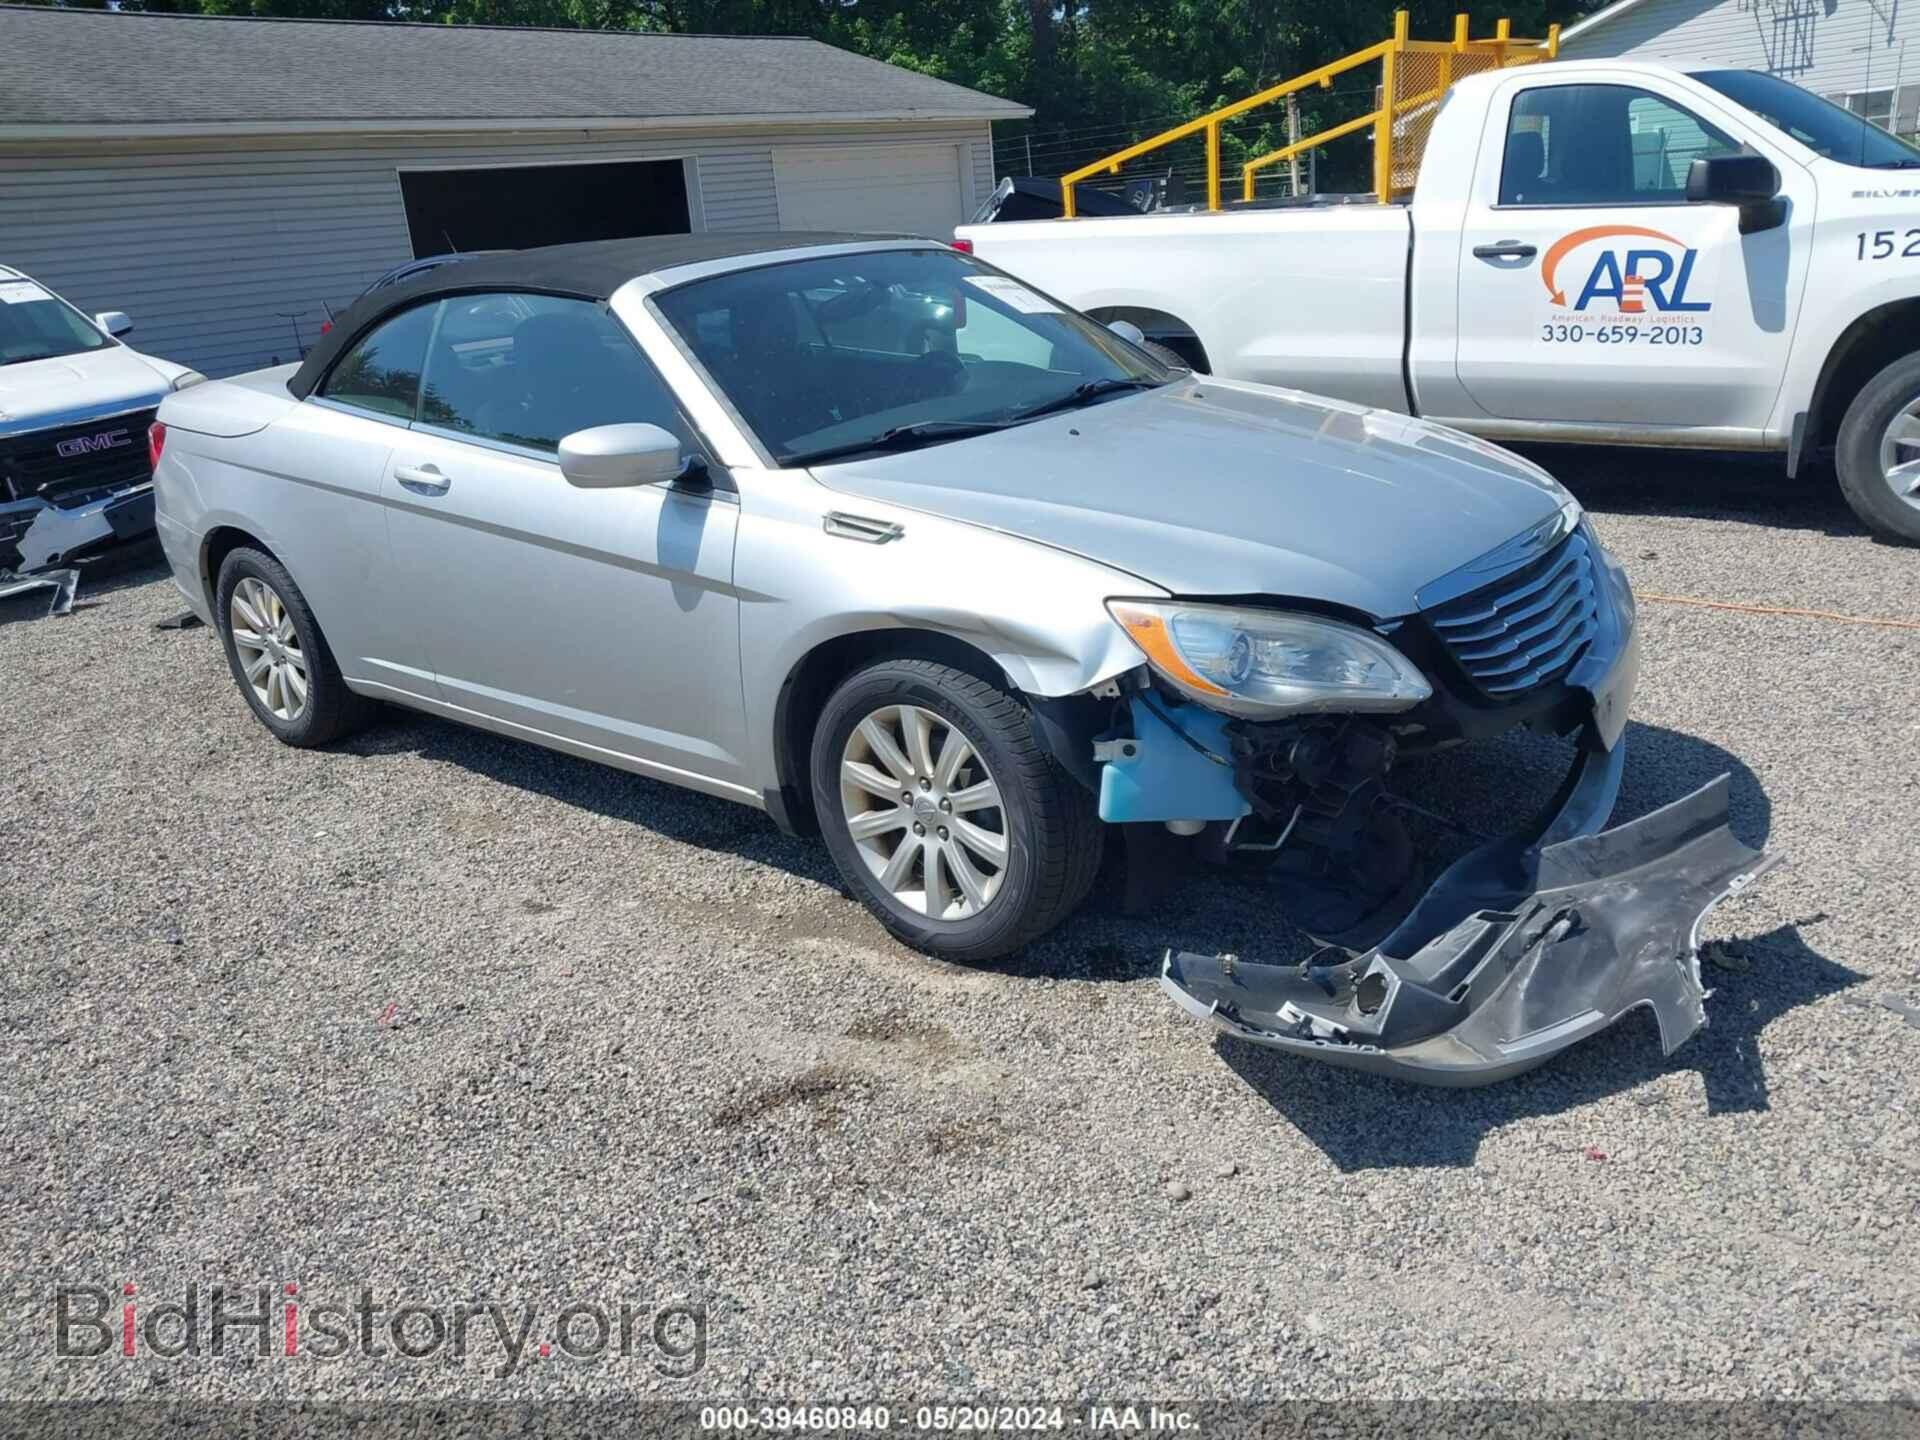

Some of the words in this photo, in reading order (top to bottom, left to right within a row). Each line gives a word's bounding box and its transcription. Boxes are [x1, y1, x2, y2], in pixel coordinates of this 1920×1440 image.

[1857, 228, 1920, 261] 152
[1574, 248, 1712, 313] ARL
[1552, 314, 1595, 323] American
[1601, 314, 1643, 324] Roadway
[1650, 314, 1696, 324] Logistics
[1541, 324, 1703, 345] 330-659-2013
[56, 429, 132, 457] GMC
